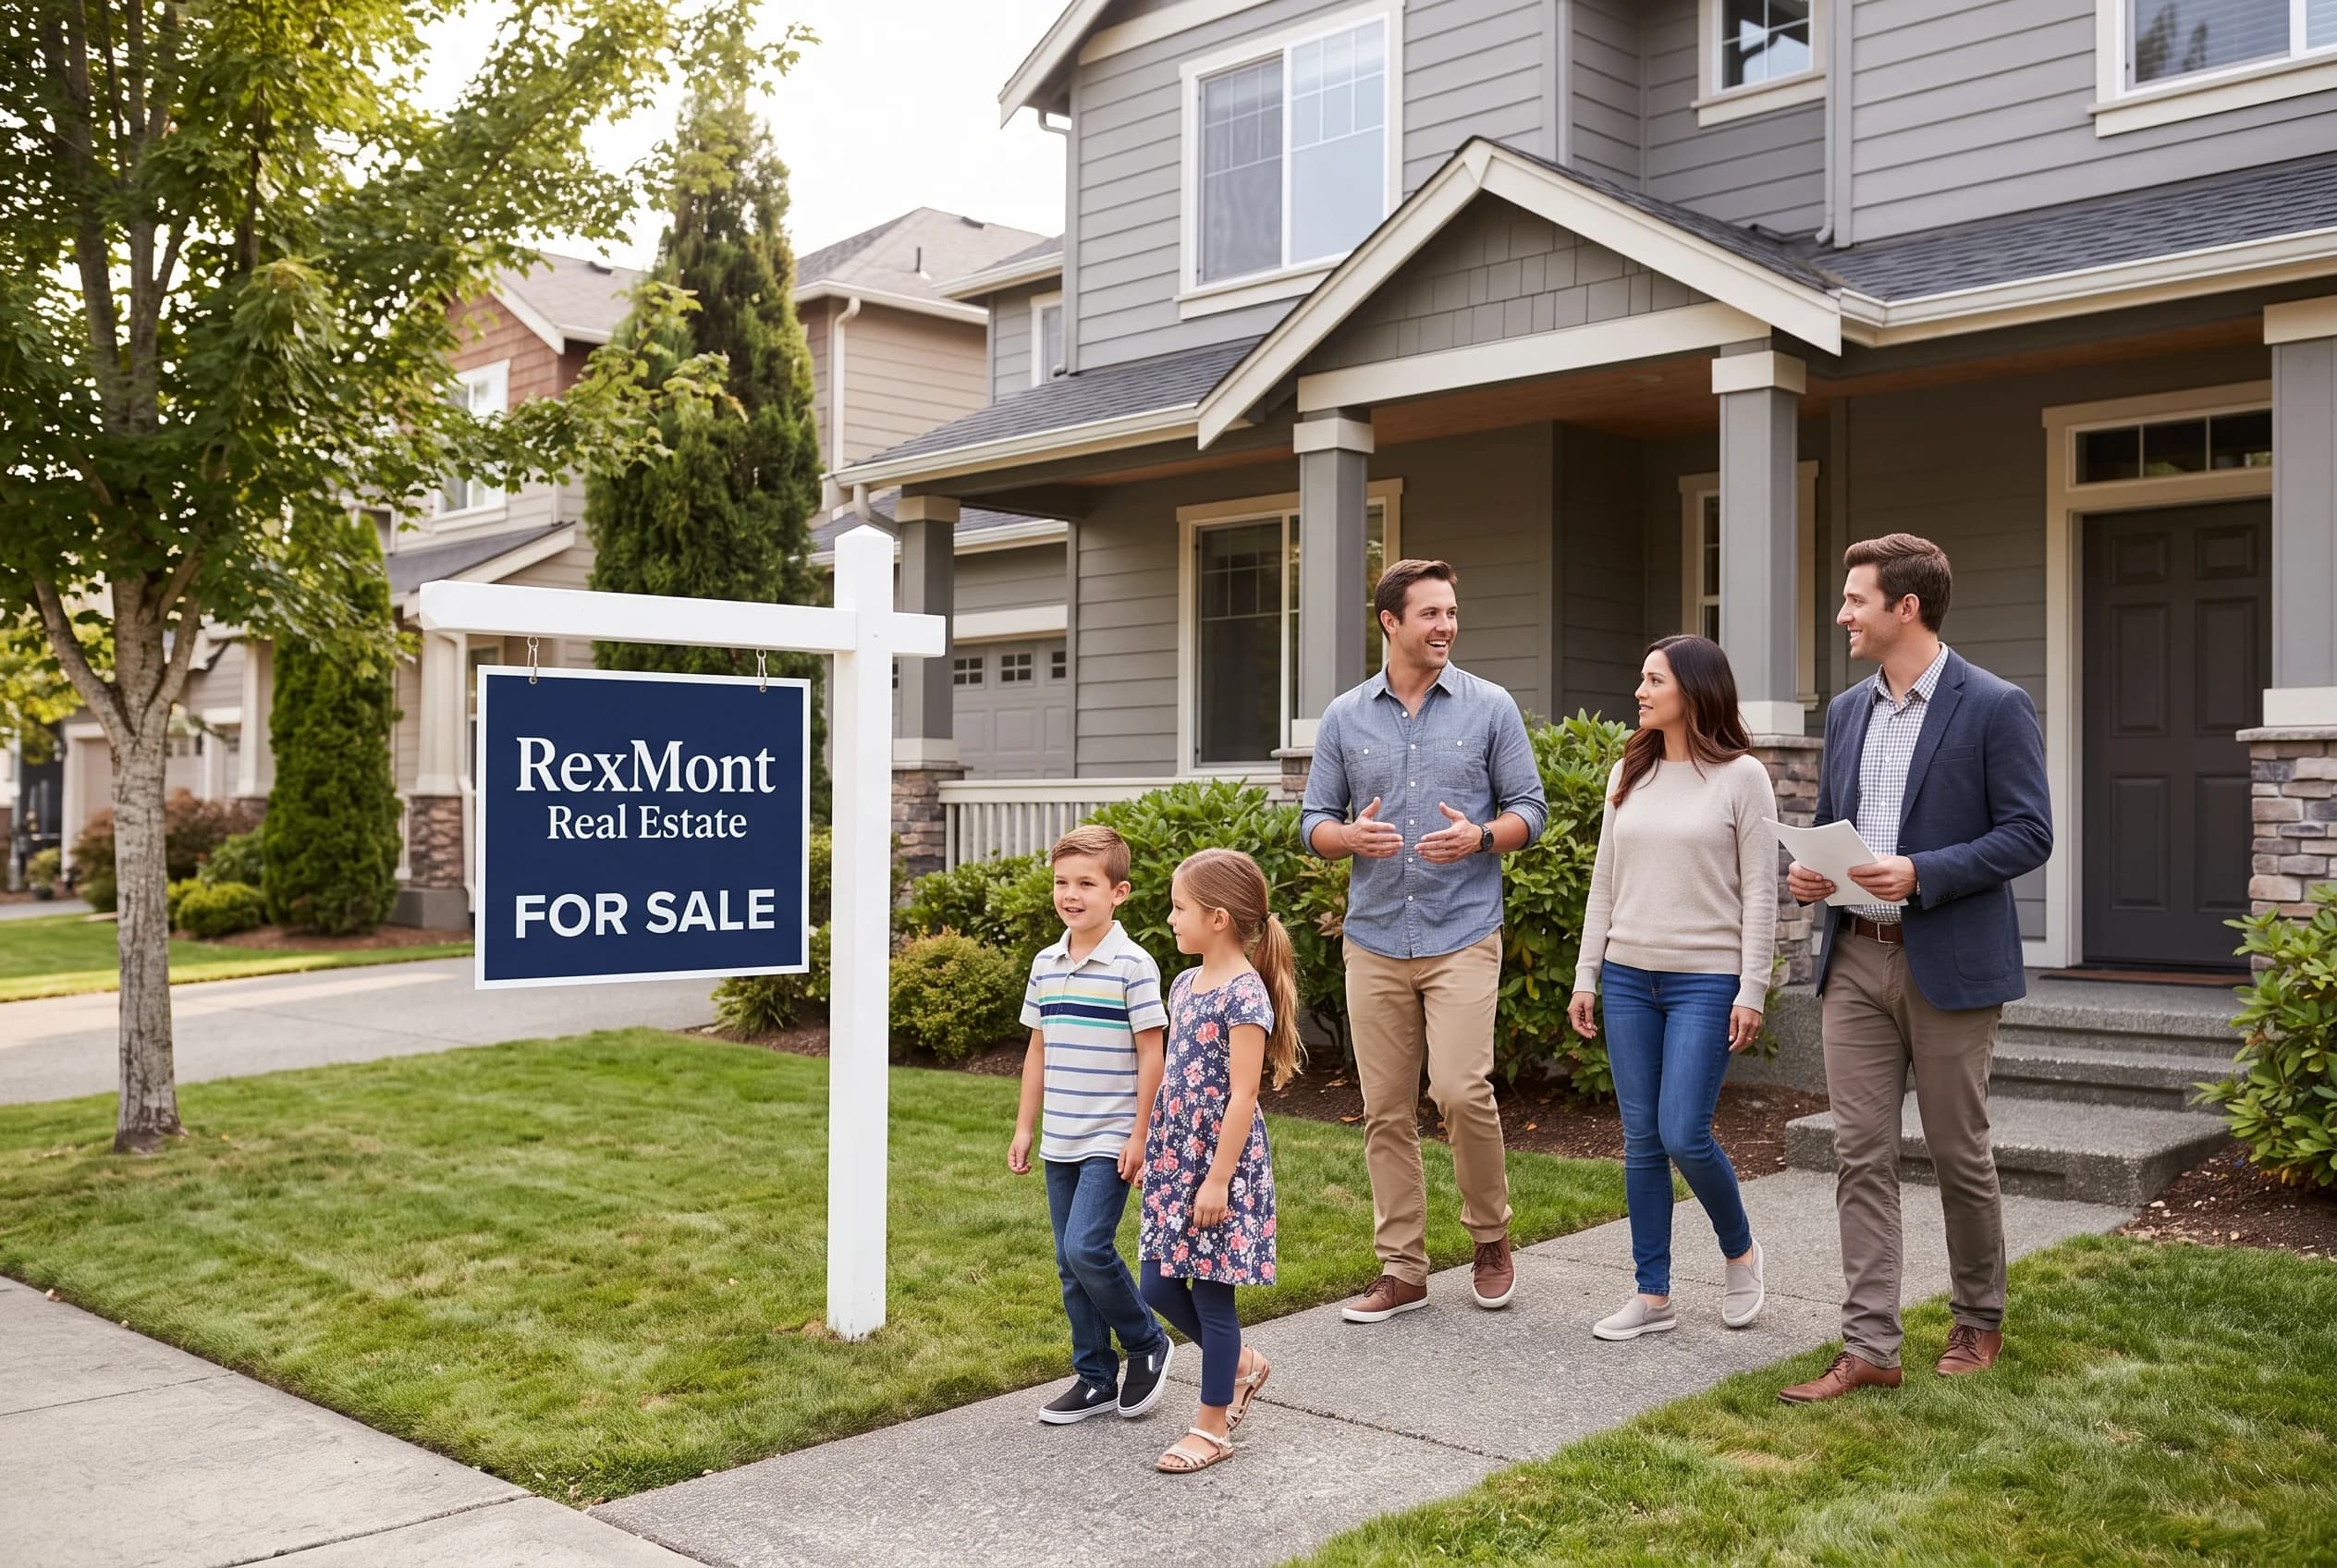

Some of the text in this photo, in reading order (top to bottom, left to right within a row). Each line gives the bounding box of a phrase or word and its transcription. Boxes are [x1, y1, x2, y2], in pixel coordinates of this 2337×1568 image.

[515, 737, 776, 793] RexMont
[546, 803, 748, 839] Real Estate
[515, 888, 776, 938] FOR SALE
